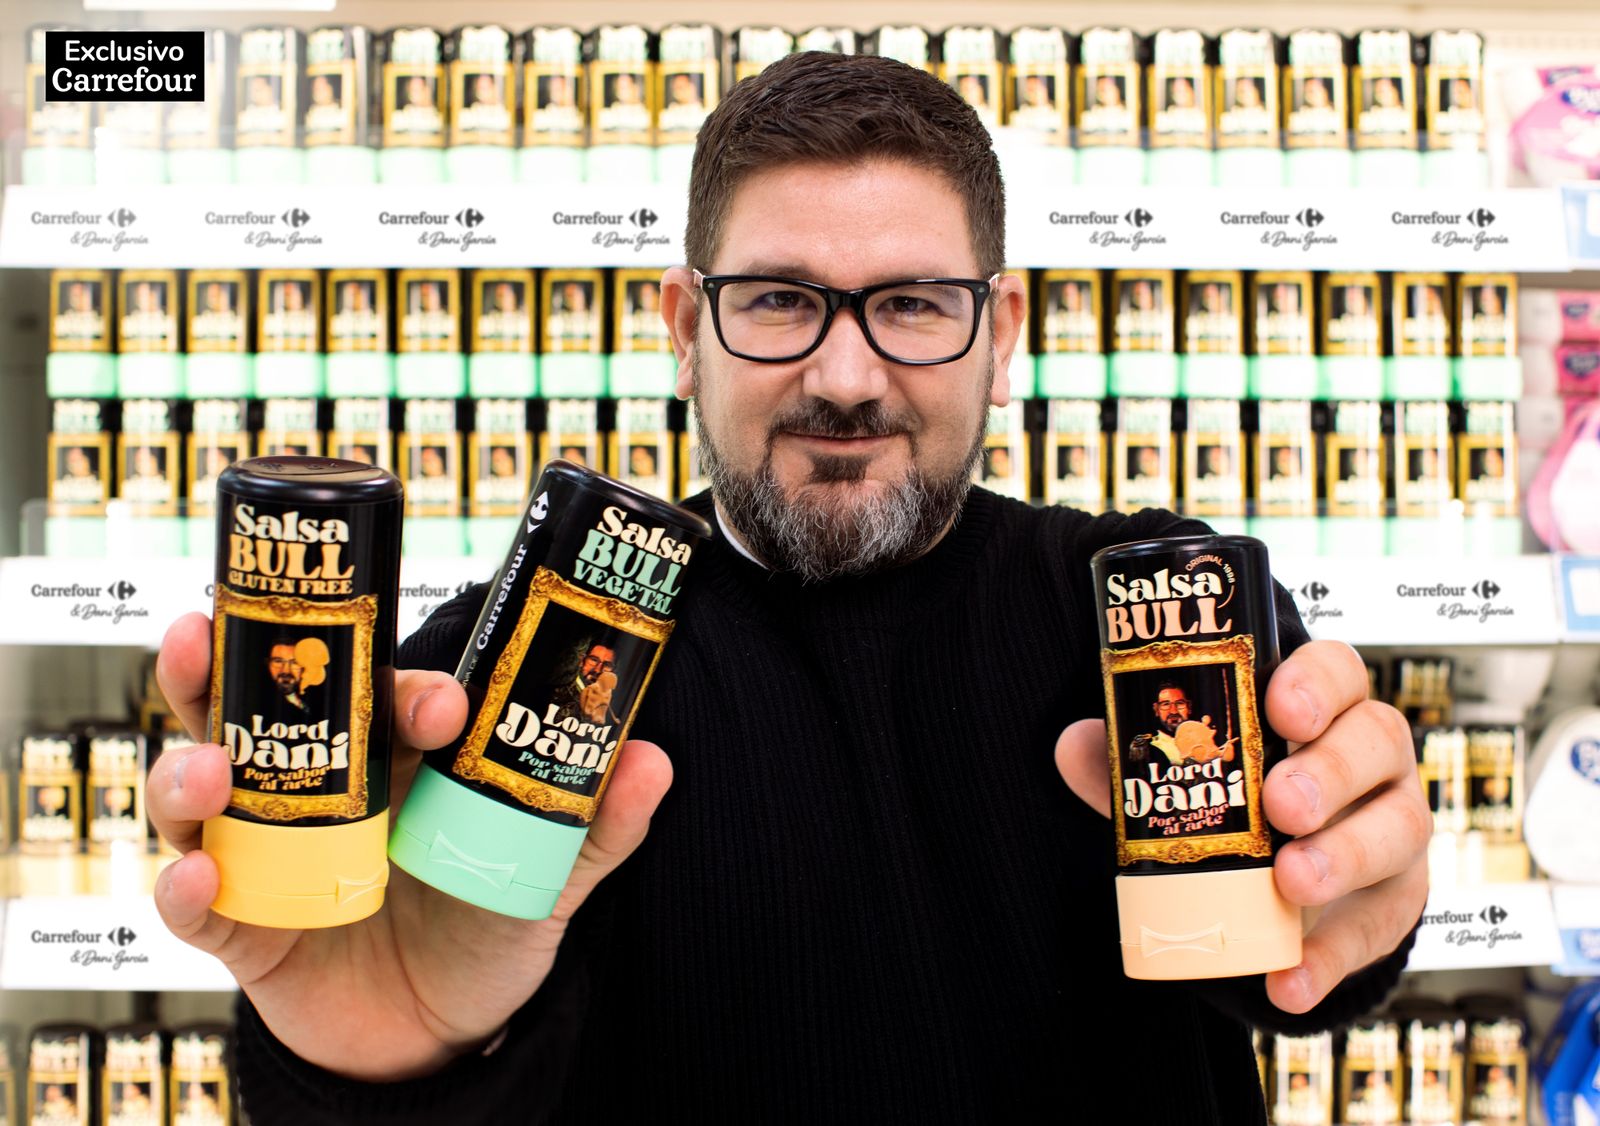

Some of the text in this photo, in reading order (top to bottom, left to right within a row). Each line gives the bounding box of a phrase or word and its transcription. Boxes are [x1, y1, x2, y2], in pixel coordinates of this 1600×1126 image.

[31, 211, 102, 226] Carrefour
[205, 211, 276, 226] Carrefour
[378, 211, 449, 226] Carrefour
[552, 211, 622, 226] Carrefour
[1049, 211, 1118, 226] Carrefour
[1220, 211, 1290, 226] Carrefour
[1392, 211, 1461, 226] Carrefour
[70, 231, 80, 244] &
[81, 231, 113, 248] Dani
[244, 231, 254, 244] &
[255, 231, 287, 248] Dani
[418, 231, 428, 244] &
[428, 231, 460, 248] Dani
[592, 231, 602, 244] &
[602, 231, 634, 248] Dani
[1088, 231, 1098, 244] &
[1098, 231, 1130, 248] Dani
[1260, 231, 1270, 244] &
[1270, 231, 1302, 248] Dani
[1431, 231, 1441, 244] &
[1441, 231, 1473, 248] Dani
[234, 503, 349, 543] Salsa
[597, 505, 692, 566] Salsa
[229, 533, 355, 580] BULL
[578, 528, 682, 597] BULL
[1185, 554, 1223, 571] ORIGINAL
[31, 584, 102, 597] Carrefour
[228, 570, 295, 594] GLUTEN
[300, 579, 353, 595] FREE
[399, 584, 449, 597] rrefour
[573, 559, 673, 615] VEGETAL
[1107, 568, 1223, 606] Salsa
[1396, 584, 1466, 597] Carrefour
[476, 543, 527, 650] Carrefour
[70, 604, 80, 617] &
[81, 604, 113, 621] Dani
[1106, 597, 1233, 643] BULL
[1436, 603, 1446, 616] &
[1447, 603, 1479, 620] Dani
[252, 714, 329, 740] Lord
[542, 703, 612, 744] Lord
[222, 722, 349, 770] Dani
[495, 702, 618, 774] Dani
[518, 751, 597, 776] Por sabor
[1148, 757, 1223, 784] Lord
[244, 765, 331, 782] Por sabor
[531, 767, 587, 785] al arte
[259, 777, 324, 791] al arte
[1124, 769, 1246, 818] Dani
[1148, 803, 1230, 828] Por sabor
[1163, 815, 1224, 836] al arte
[1422, 910, 1474, 925] rrefour
[31, 930, 102, 943] Carrefour
[1445, 930, 1456, 944] &
[1456, 929, 1487, 946] Dani
[70, 950, 80, 963] &
[81, 950, 113, 967] Dani
